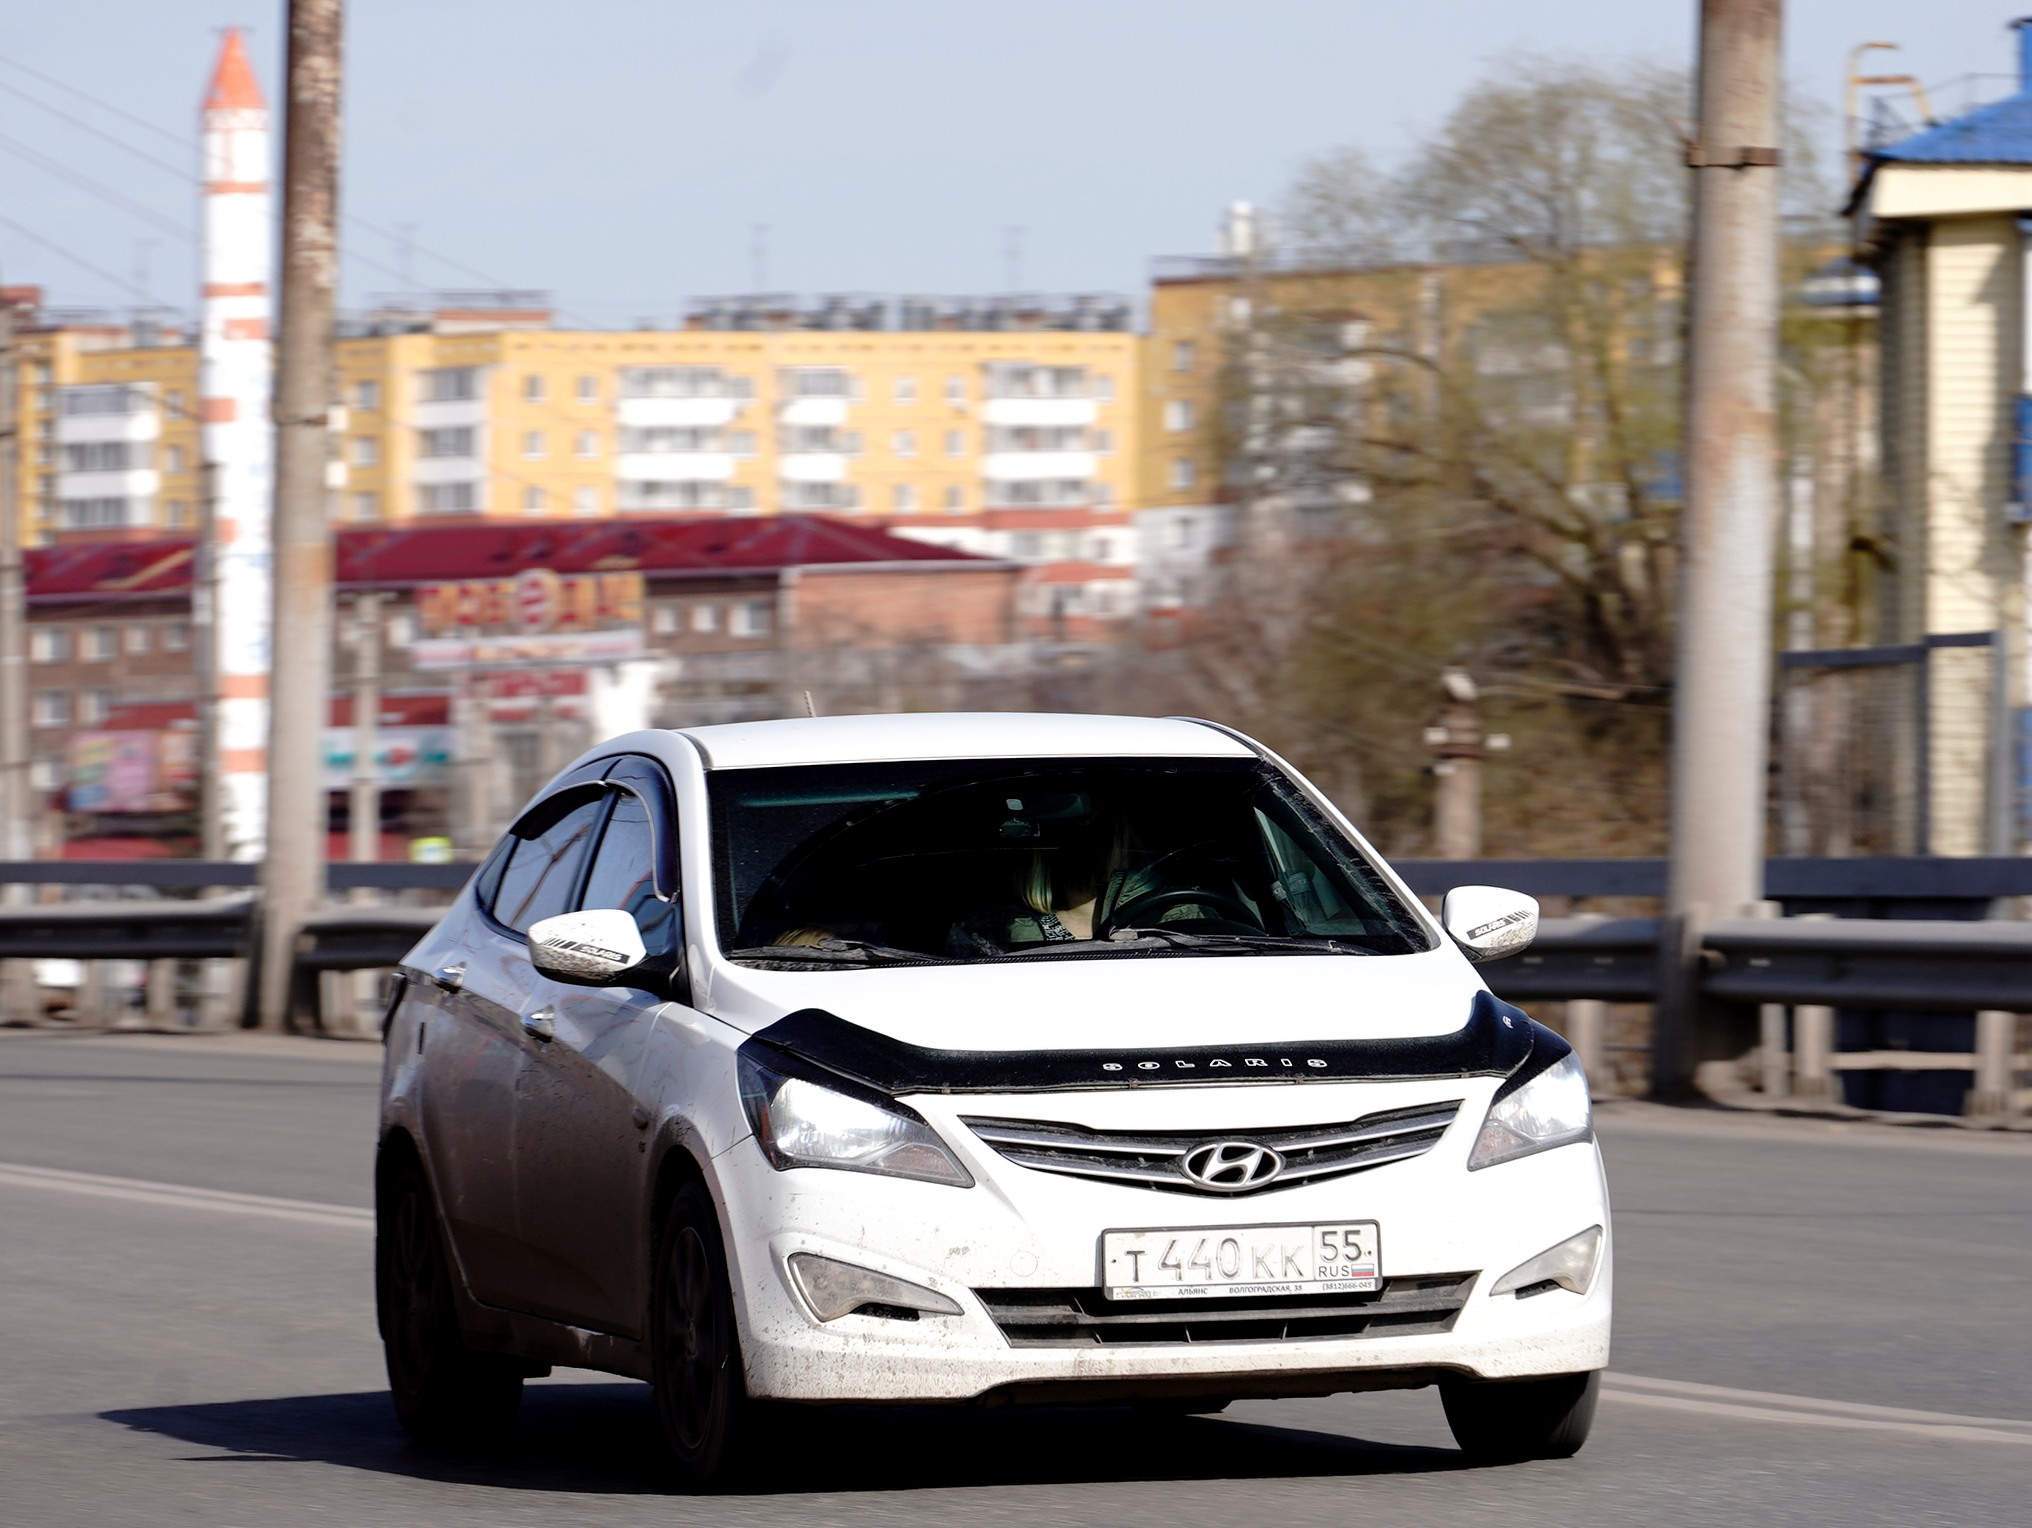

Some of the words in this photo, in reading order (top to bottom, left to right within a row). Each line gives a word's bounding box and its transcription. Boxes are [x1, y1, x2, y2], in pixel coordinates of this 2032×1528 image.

[1102, 1058, 1328, 1072] SOLARIS
[1319, 1229, 1362, 1263] 55
[1318, 1264, 1350, 1278] RUS
[1178, 1287, 1208, 1295] АЛЬЯНС
[1293, 1284, 1303, 1292] 38
